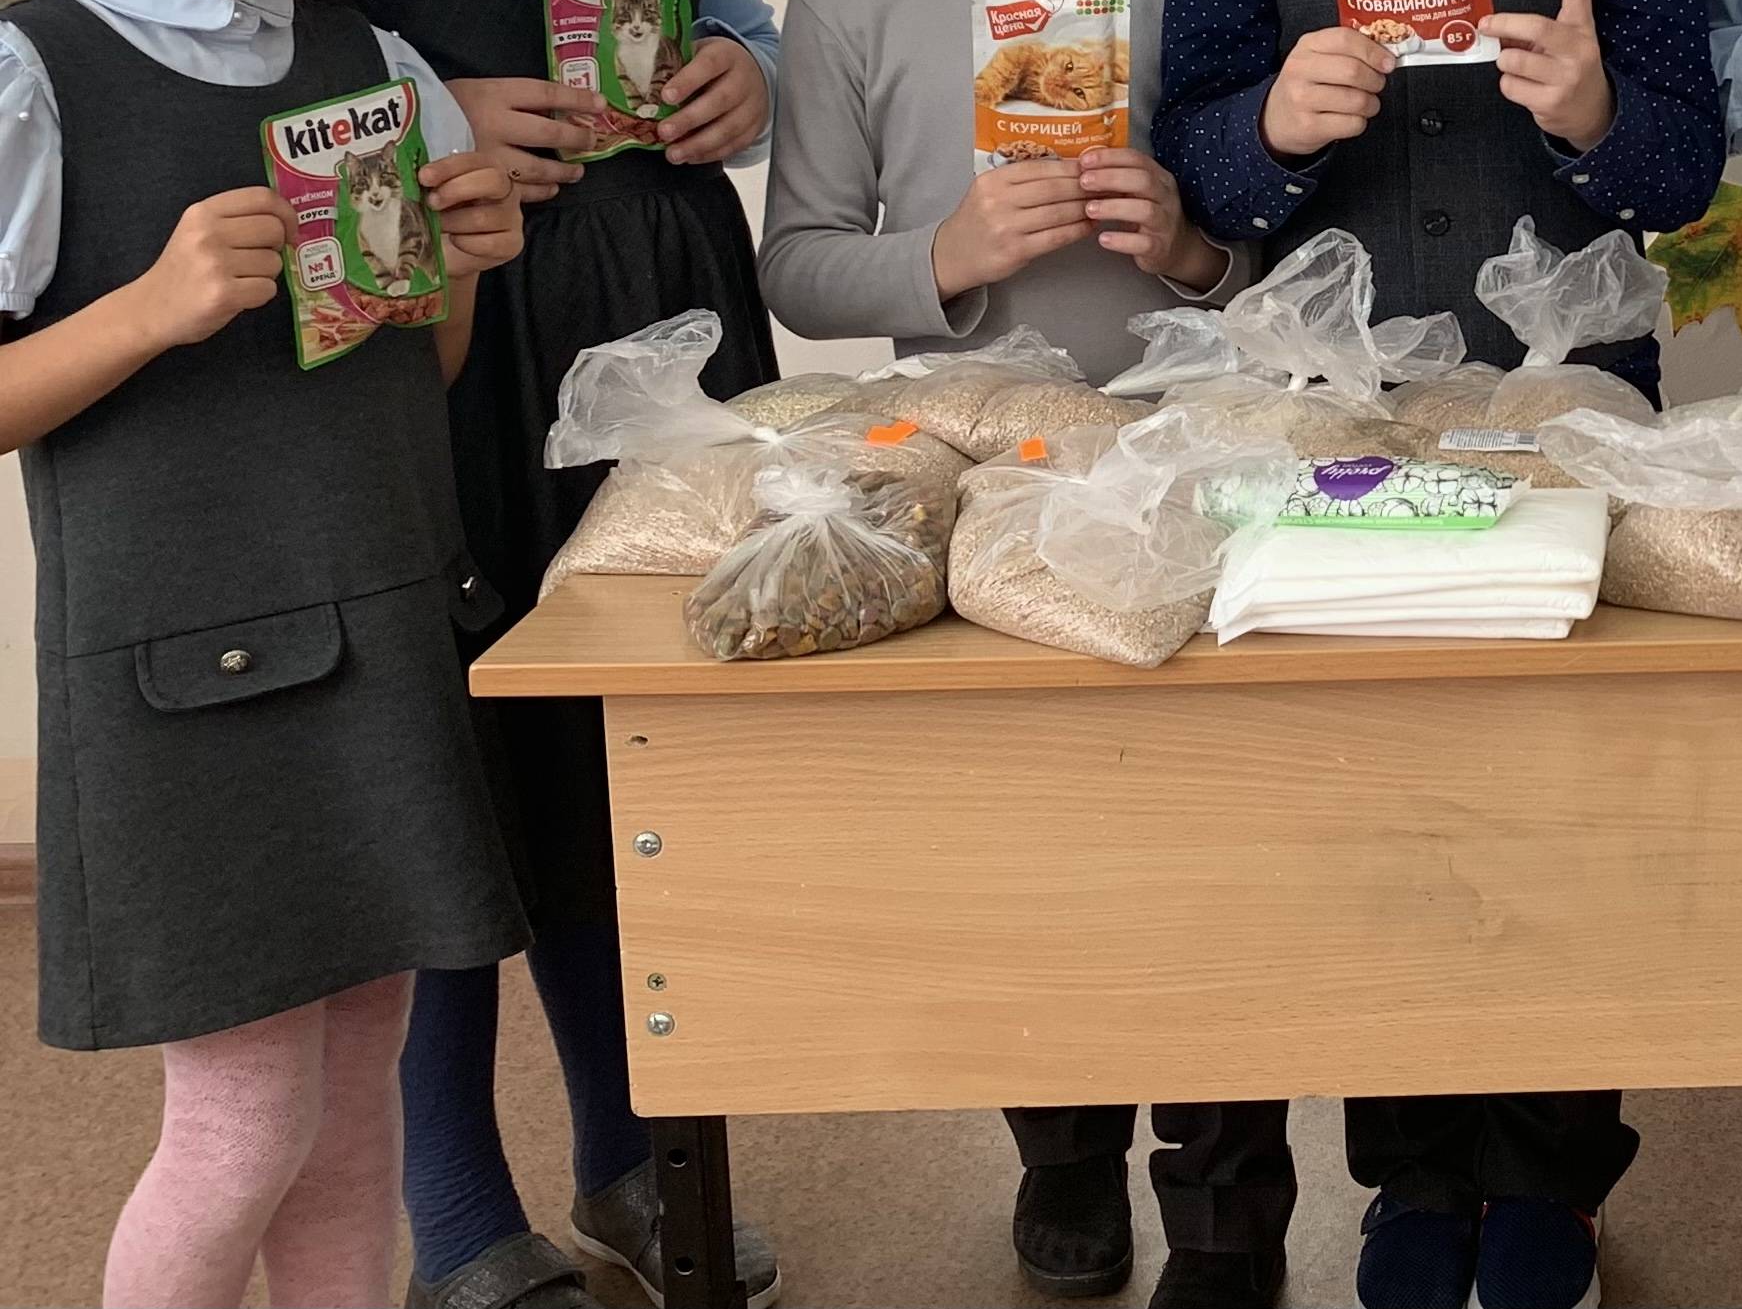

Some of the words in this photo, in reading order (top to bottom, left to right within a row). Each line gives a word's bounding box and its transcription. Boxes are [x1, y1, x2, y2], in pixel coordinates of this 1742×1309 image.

[989, 7, 1042, 25] Красная
[994, 22, 1026, 37] цена
[1446, 32, 1463, 44] 85
[284, 98, 401, 159] kitekat
[1010, 121, 1083, 136] КУРИЦЕЙ
